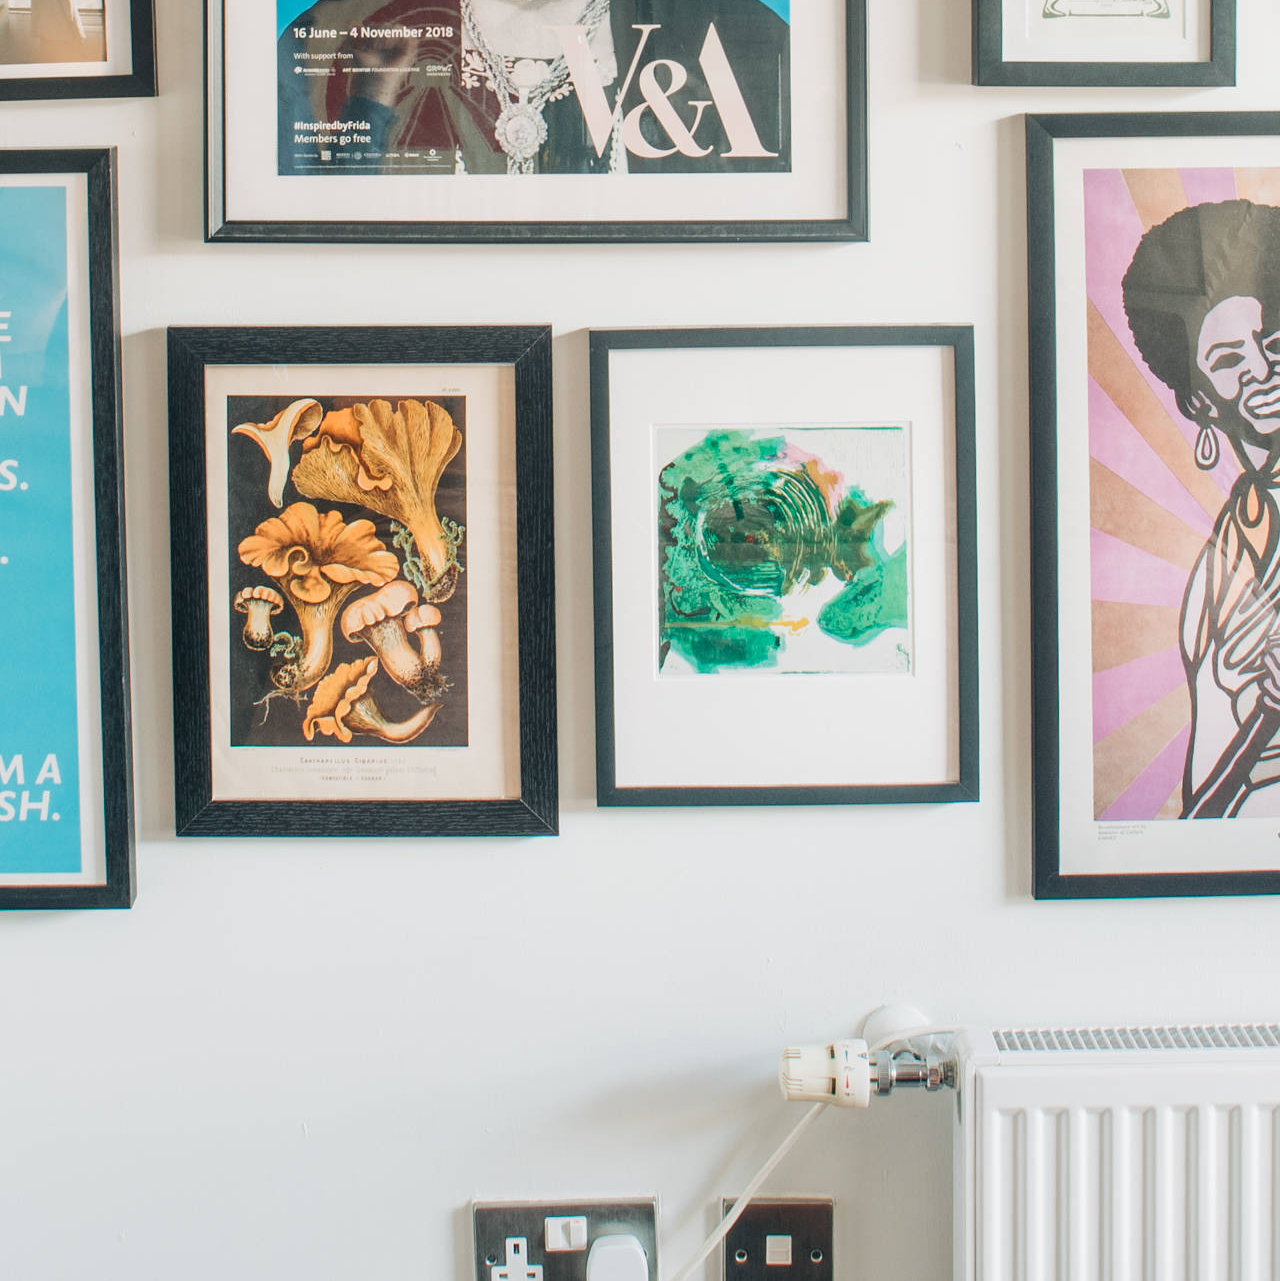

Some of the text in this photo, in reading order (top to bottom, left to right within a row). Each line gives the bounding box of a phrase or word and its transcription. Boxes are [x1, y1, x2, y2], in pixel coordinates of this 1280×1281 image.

[294, 28, 306, 38] 16
[309, 27, 337, 38] June
[350, 28, 358, 38] 4
[361, 26, 422, 38] November
[425, 27, 453, 38] 2018
[311, 53, 336, 62] support
[543, 22, 779, 160] V&A
[294, 121, 371, 132] #InspiredbyFrida
[294, 134, 371, 145] Members go free
[35, 754, 61, 784] A
